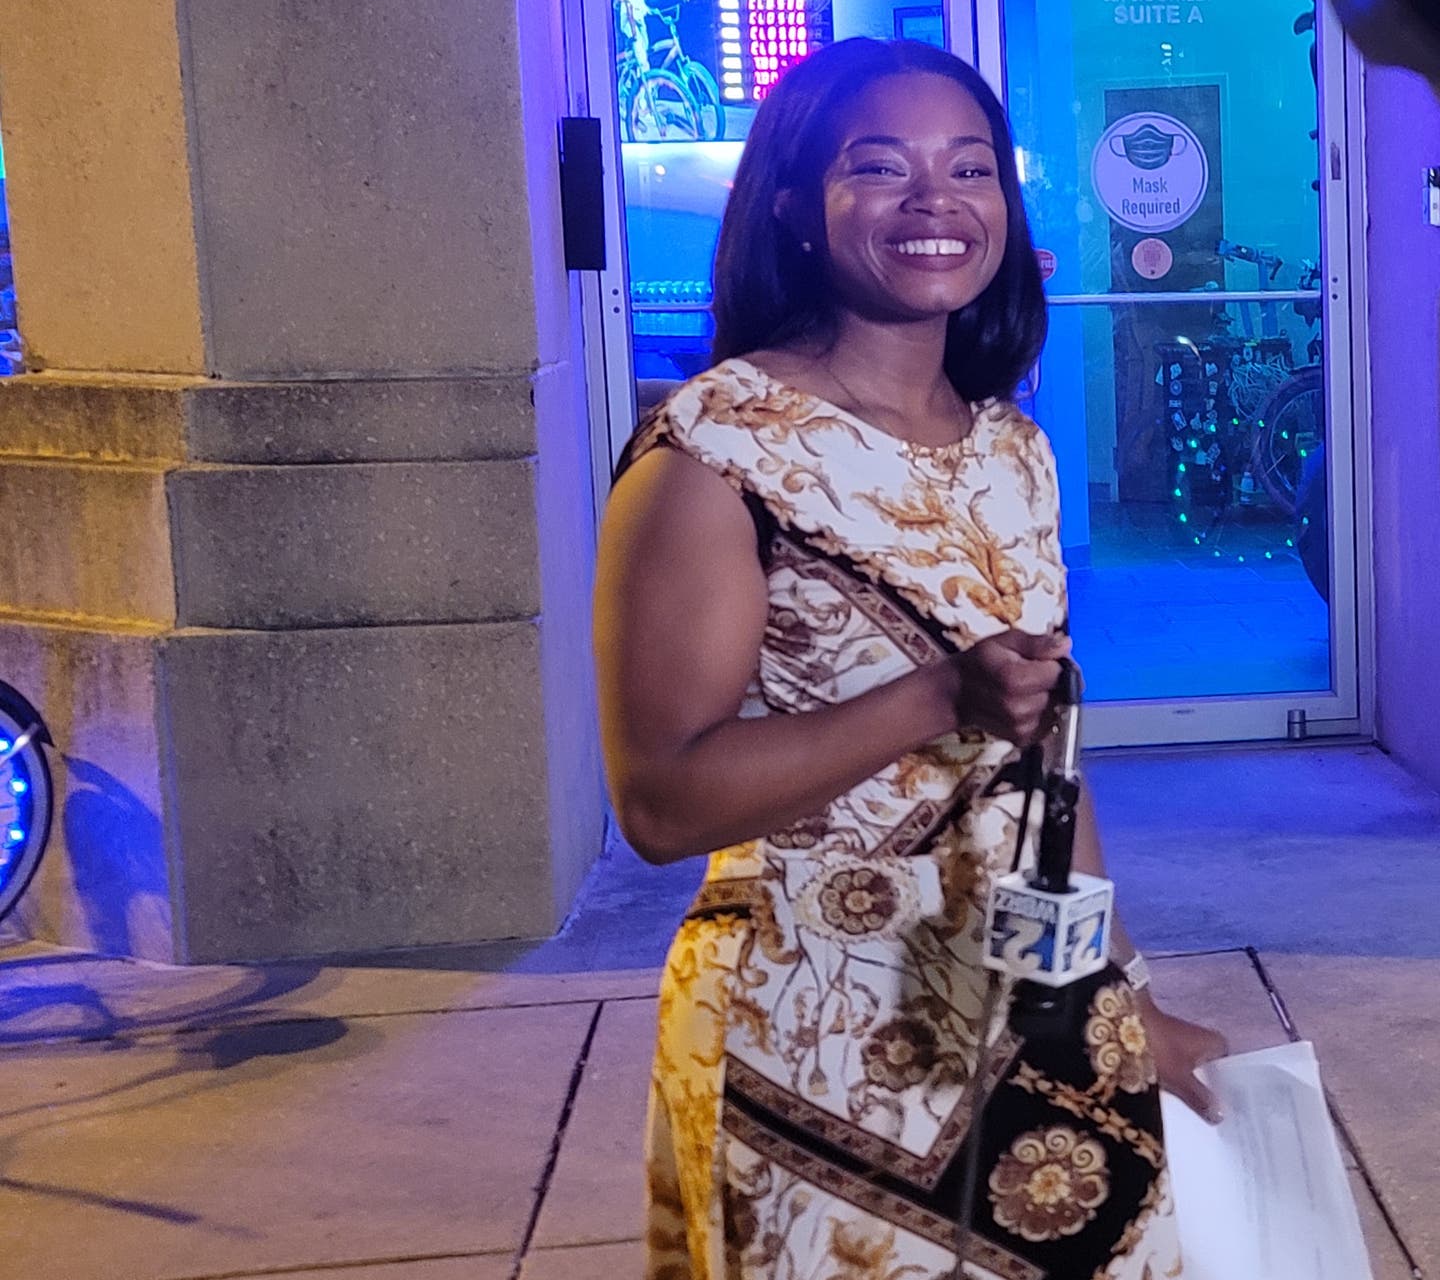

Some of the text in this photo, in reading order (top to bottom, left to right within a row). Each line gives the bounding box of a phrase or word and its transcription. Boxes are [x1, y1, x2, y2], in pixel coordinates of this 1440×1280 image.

[1114, 4, 1203, 24] SUITE A
[1132, 177, 1168, 194] Mask
[1121, 198, 1181, 219] Required
